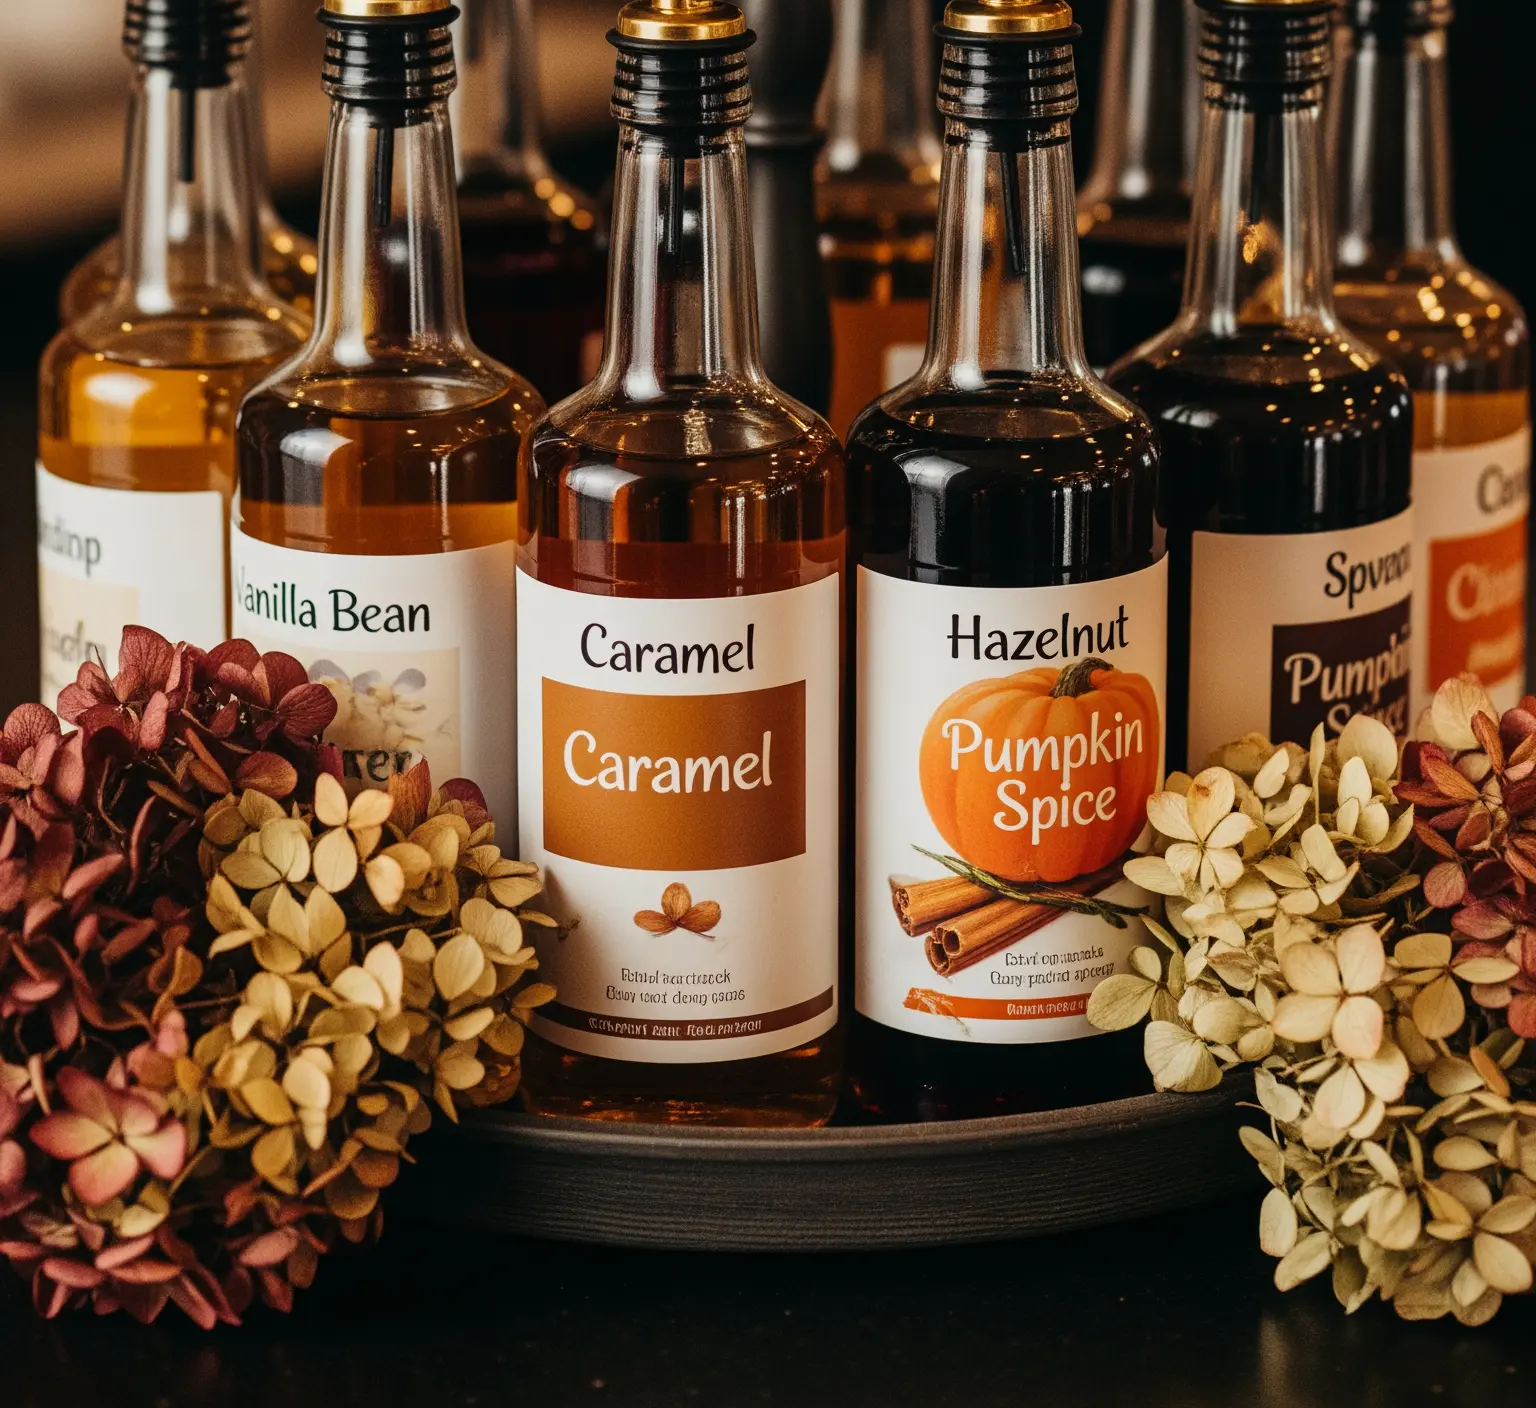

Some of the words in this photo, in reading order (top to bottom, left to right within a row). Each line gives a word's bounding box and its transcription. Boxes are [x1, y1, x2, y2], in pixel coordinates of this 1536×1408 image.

[234, 563, 317, 630] Vanilla
[328, 588, 431, 633] Bean
[580, 622, 755, 675] Caramel
[946, 604, 1130, 661] Hazelnut
[563, 729, 773, 794] Caramel
[941, 710, 1144, 792] Pumpkin
[993, 778, 1118, 846] Spice
